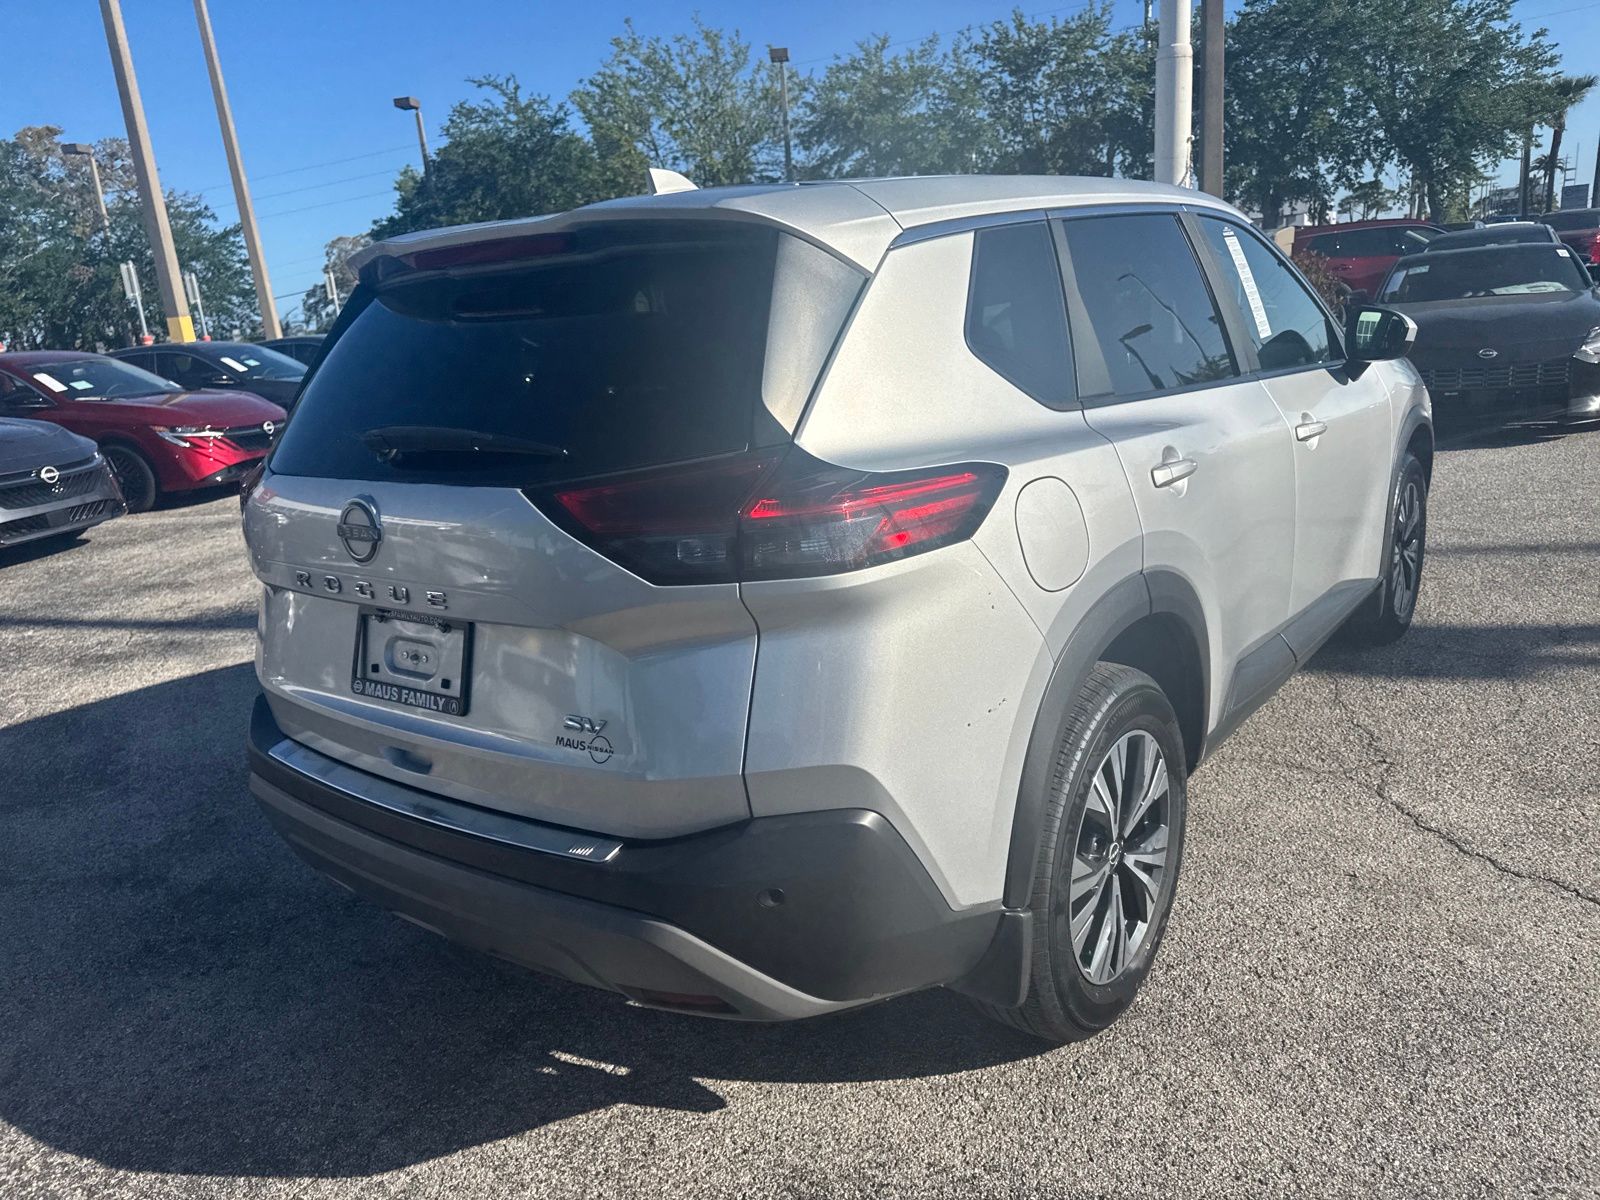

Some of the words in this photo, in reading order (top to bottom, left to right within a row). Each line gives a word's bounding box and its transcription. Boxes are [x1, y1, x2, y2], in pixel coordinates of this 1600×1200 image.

[296, 570, 448, 610] ROGUE
[364, 681, 399, 701] MAUS
[401, 689, 446, 710] FAMILY
[563, 714, 608, 735] SV
[555, 735, 586, 751] MAUS
[587, 744, 614, 755] NISSAN
